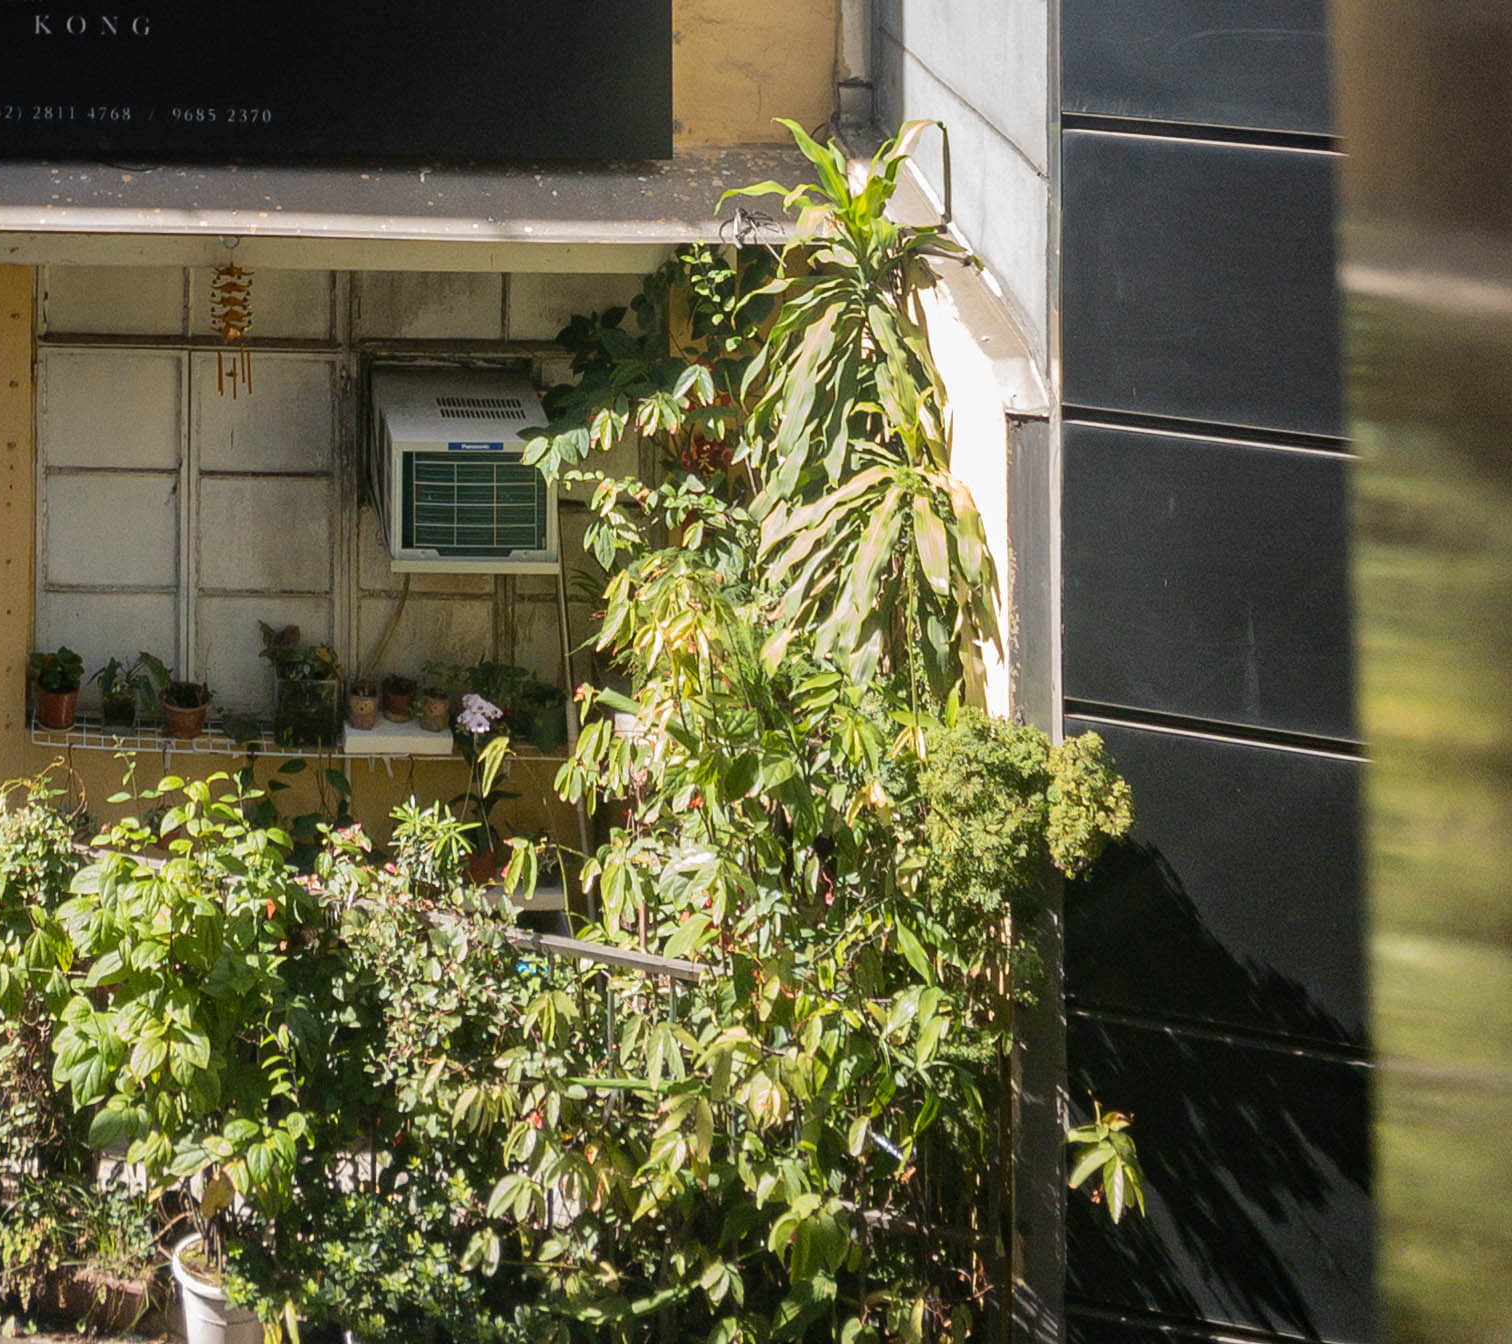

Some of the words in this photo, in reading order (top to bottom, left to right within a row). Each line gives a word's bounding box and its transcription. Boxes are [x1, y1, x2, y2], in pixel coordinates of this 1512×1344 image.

[34, 14, 150, 36] KONG
[32, 106, 76, 121] 2811
[87, 107, 131, 122] 4768
[172, 108, 217, 123] 9685
[227, 109, 272, 124] 2370
